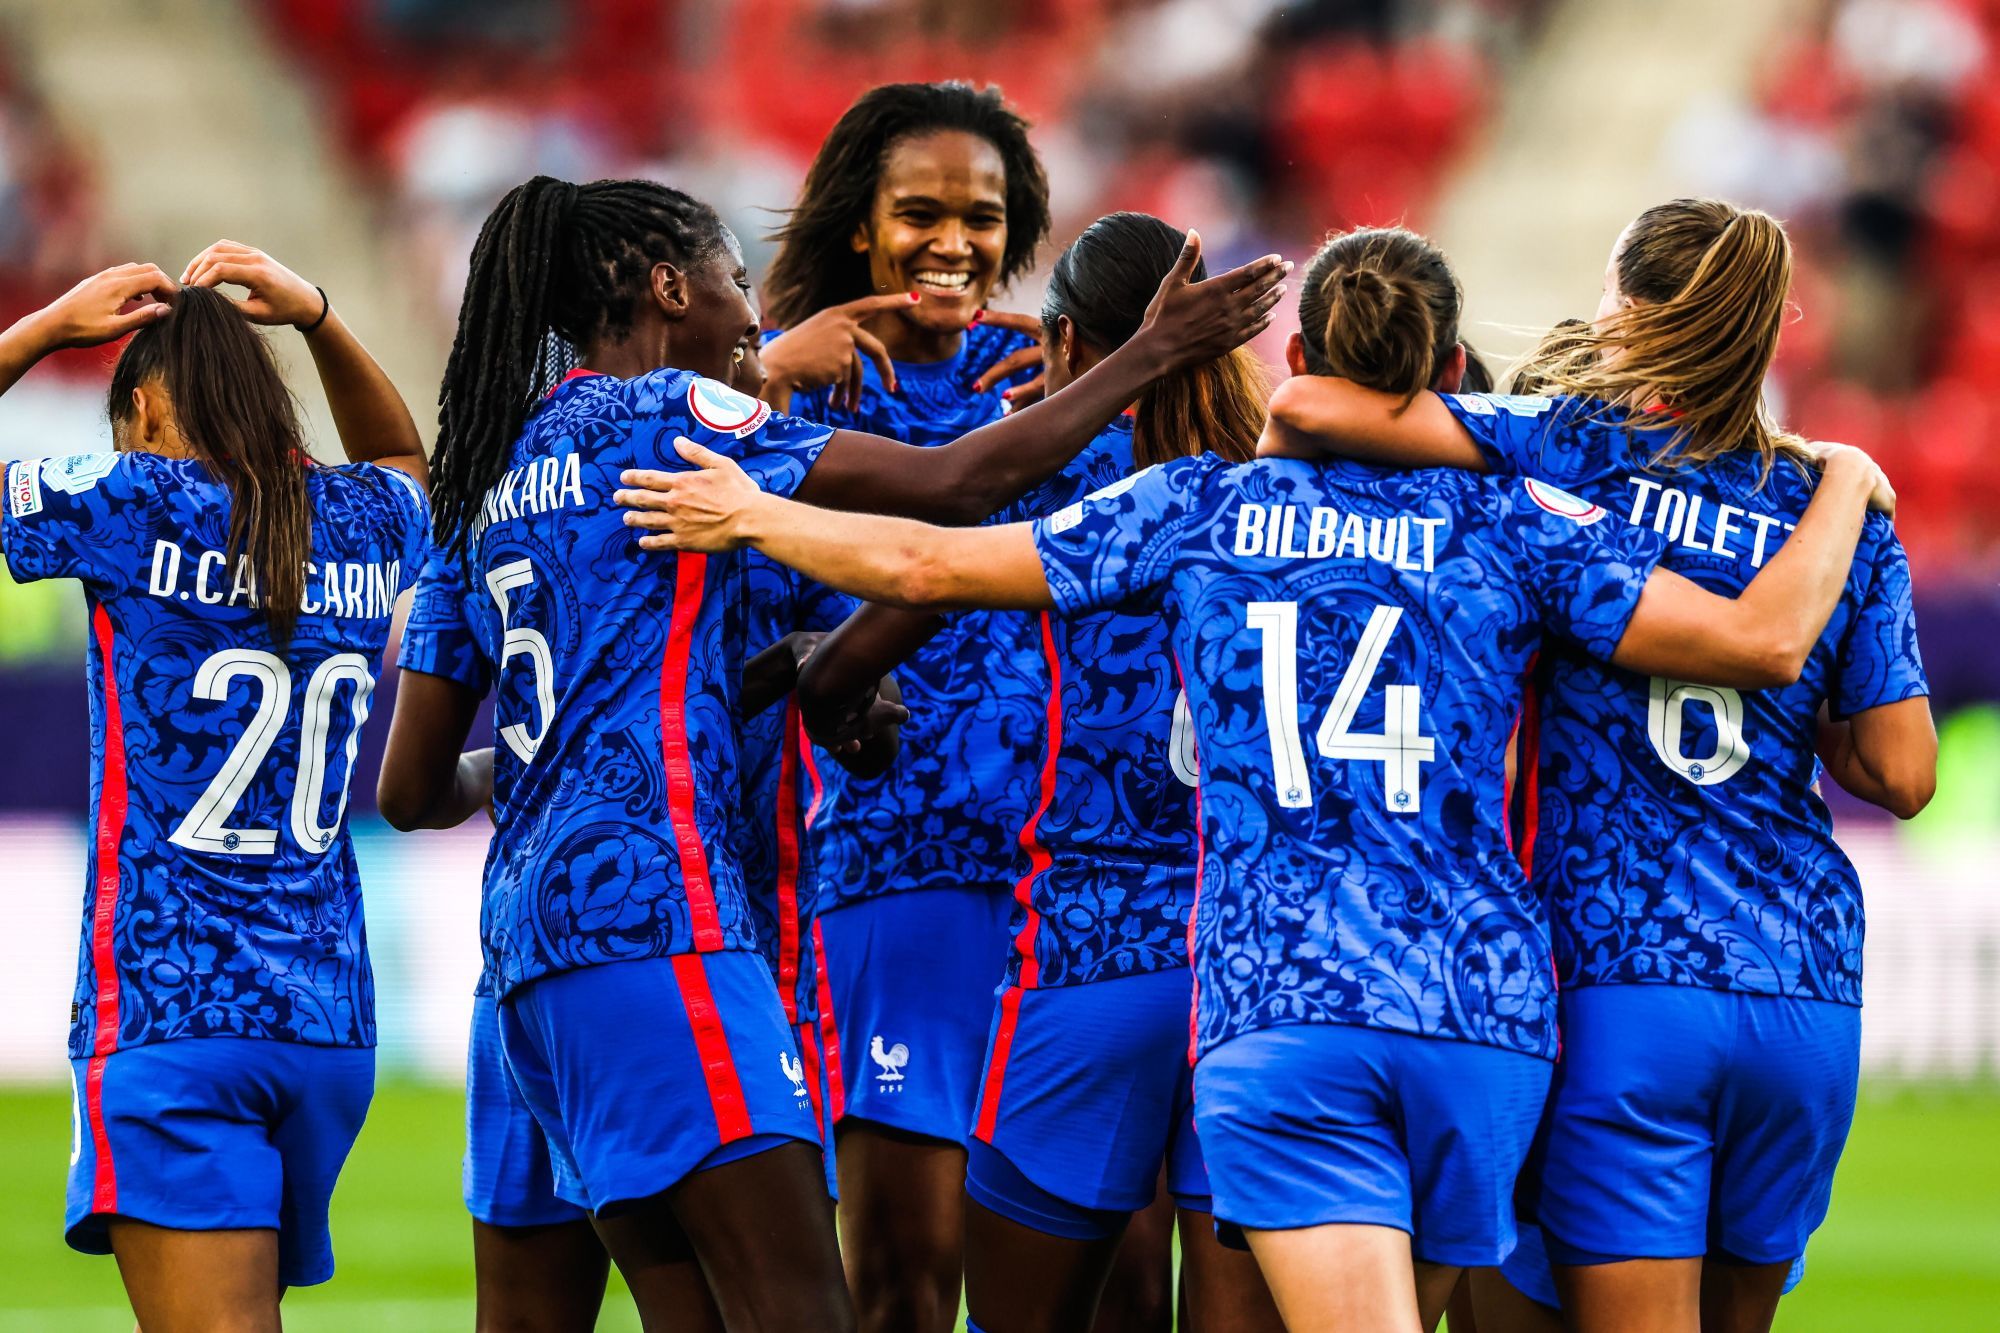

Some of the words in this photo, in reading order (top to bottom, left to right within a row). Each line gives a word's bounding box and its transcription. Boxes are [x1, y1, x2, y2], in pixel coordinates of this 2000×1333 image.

[740, 411, 768, 435] ENGLAND
[148, 538, 401, 620] D.CACARINO
[1234, 503, 1446, 572] BILBAULT
[485, 558, 555, 765] 5
[1246, 601, 1436, 813] 14
[166, 647, 376, 856] 20
